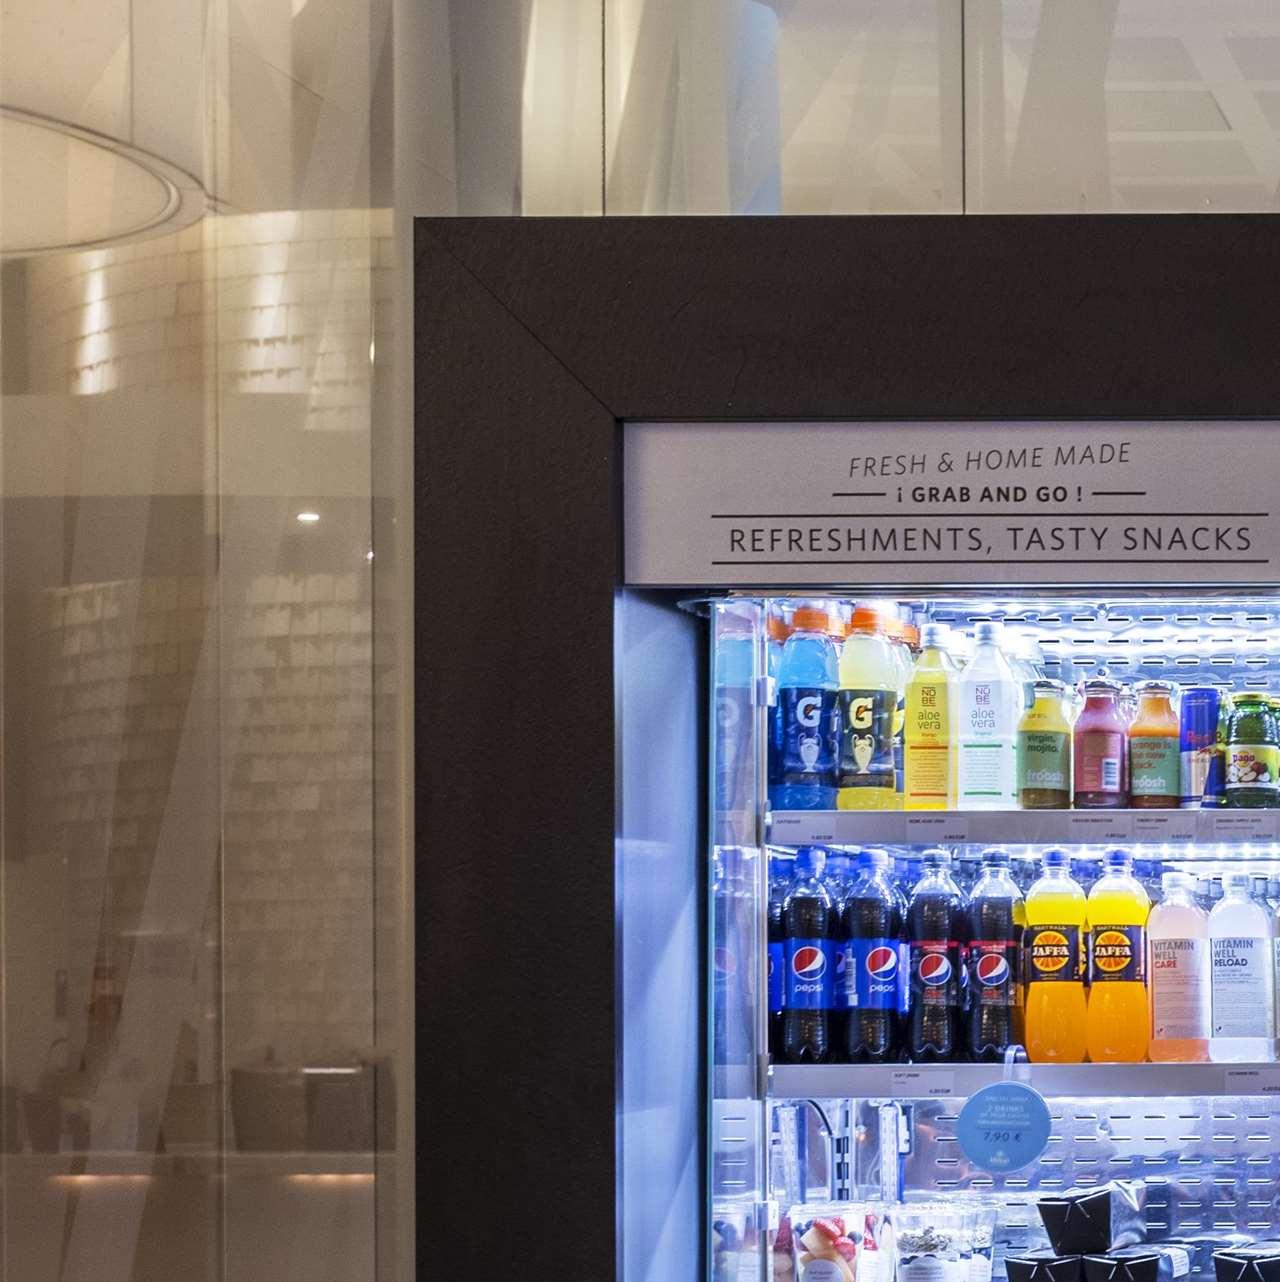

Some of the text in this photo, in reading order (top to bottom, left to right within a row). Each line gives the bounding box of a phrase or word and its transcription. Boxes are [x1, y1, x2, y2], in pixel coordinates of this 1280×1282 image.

[849, 441, 1132, 478] FRESH & HOME MADE
[912, 486, 972, 503] GRAB
[980, 485, 1029, 502] AND
[1036, 485, 1069, 502] GO
[729, 526, 1252, 555] REFRESHMENTS, TASTY SNACKS
[918, 710, 941, 720] aloe
[971, 709, 995, 720] aloe
[918, 720, 941, 730] vera
[971, 719, 996, 729] vera
[1233, 754, 1255, 763] pago
[1154, 940, 1195, 950] VITAMIN
[1213, 939, 1253, 949] VITAMIN
[1033, 946, 1070, 957] JAFFA
[1095, 946, 1131, 957] JAFFA
[1154, 950, 1177, 960] WELL
[1213, 949, 1237, 959] WELL
[1154, 960, 1177, 969] CARE
[1213, 958, 1248, 968] RELOAD
[795, 983, 824, 994] pepsi
